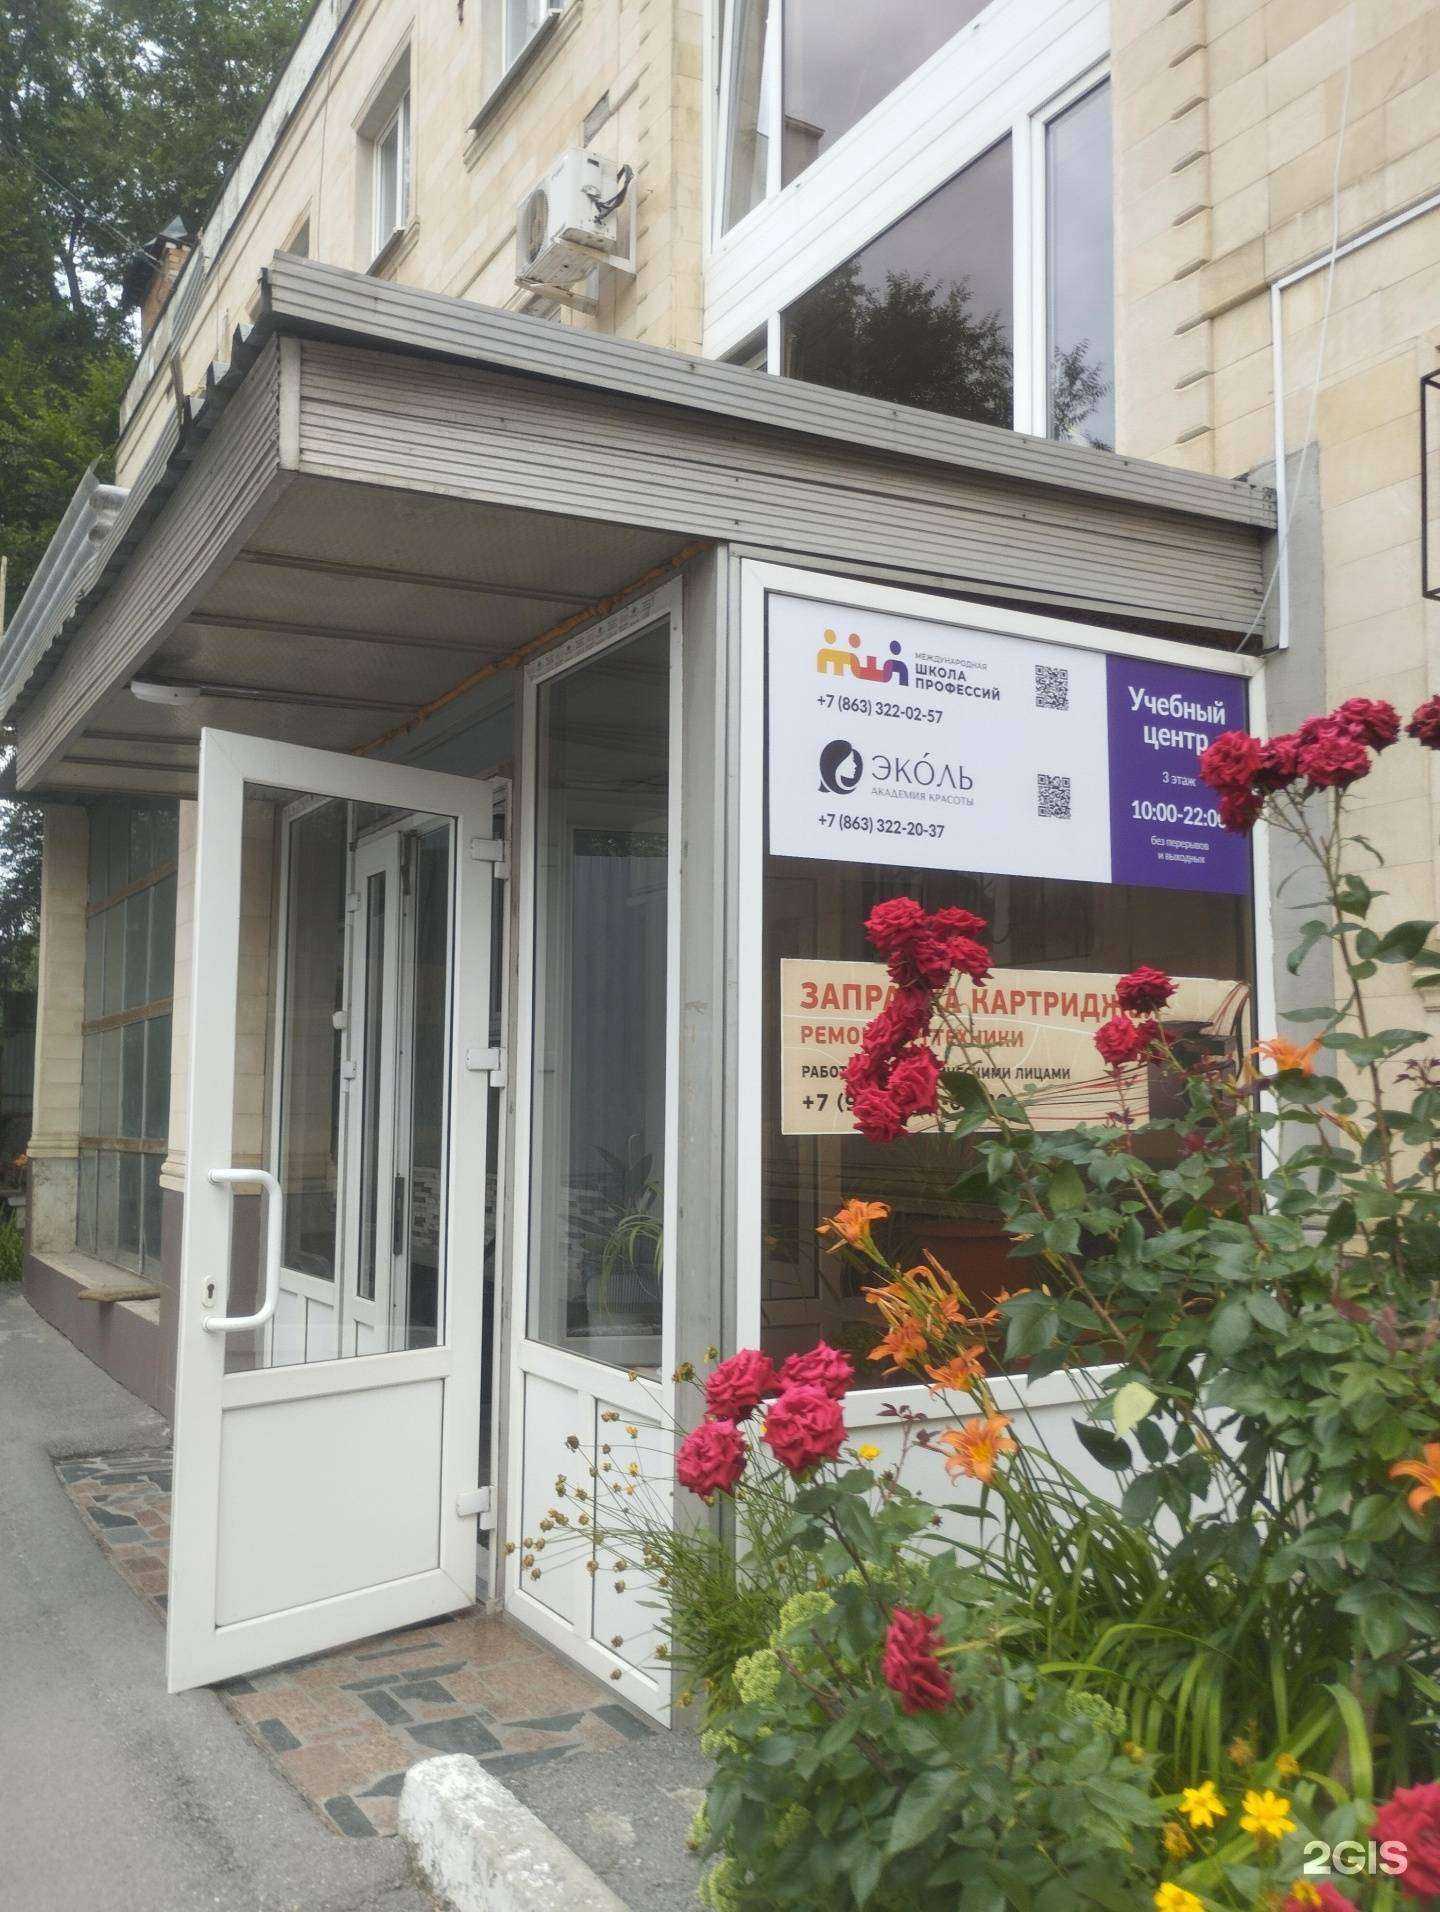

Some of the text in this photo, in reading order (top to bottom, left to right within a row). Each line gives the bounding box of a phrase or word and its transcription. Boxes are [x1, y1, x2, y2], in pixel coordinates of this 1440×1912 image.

[914, 652, 988, 671] МЕЖДУНАРОДНАЯ
[915, 663, 967, 682] ШКОЛА
[915, 677, 1001, 701] ПРОФЕССИЙ
[817, 693, 943, 724] +7 (863) 322-02-57
[1127, 686, 1226, 725] Учебный
[1143, 725, 1209, 756] центр
[1162, 771, 1197, 787] 3 этаж
[871, 787, 975, 806] АКАДЕМИЯ КРАСОТЫ
[818, 813, 945, 838] +7 (863) 322-20-37
[1150, 835, 1166, 847] без
[801, 981, 1150, 1022] ЗАПРАА КАРТРИДЖ
[801, 1025, 867, 1045] РЕМО
[1014, 1067, 1072, 1082] ЛИЦАМИ
[802, 1093, 829, 1112] +7
